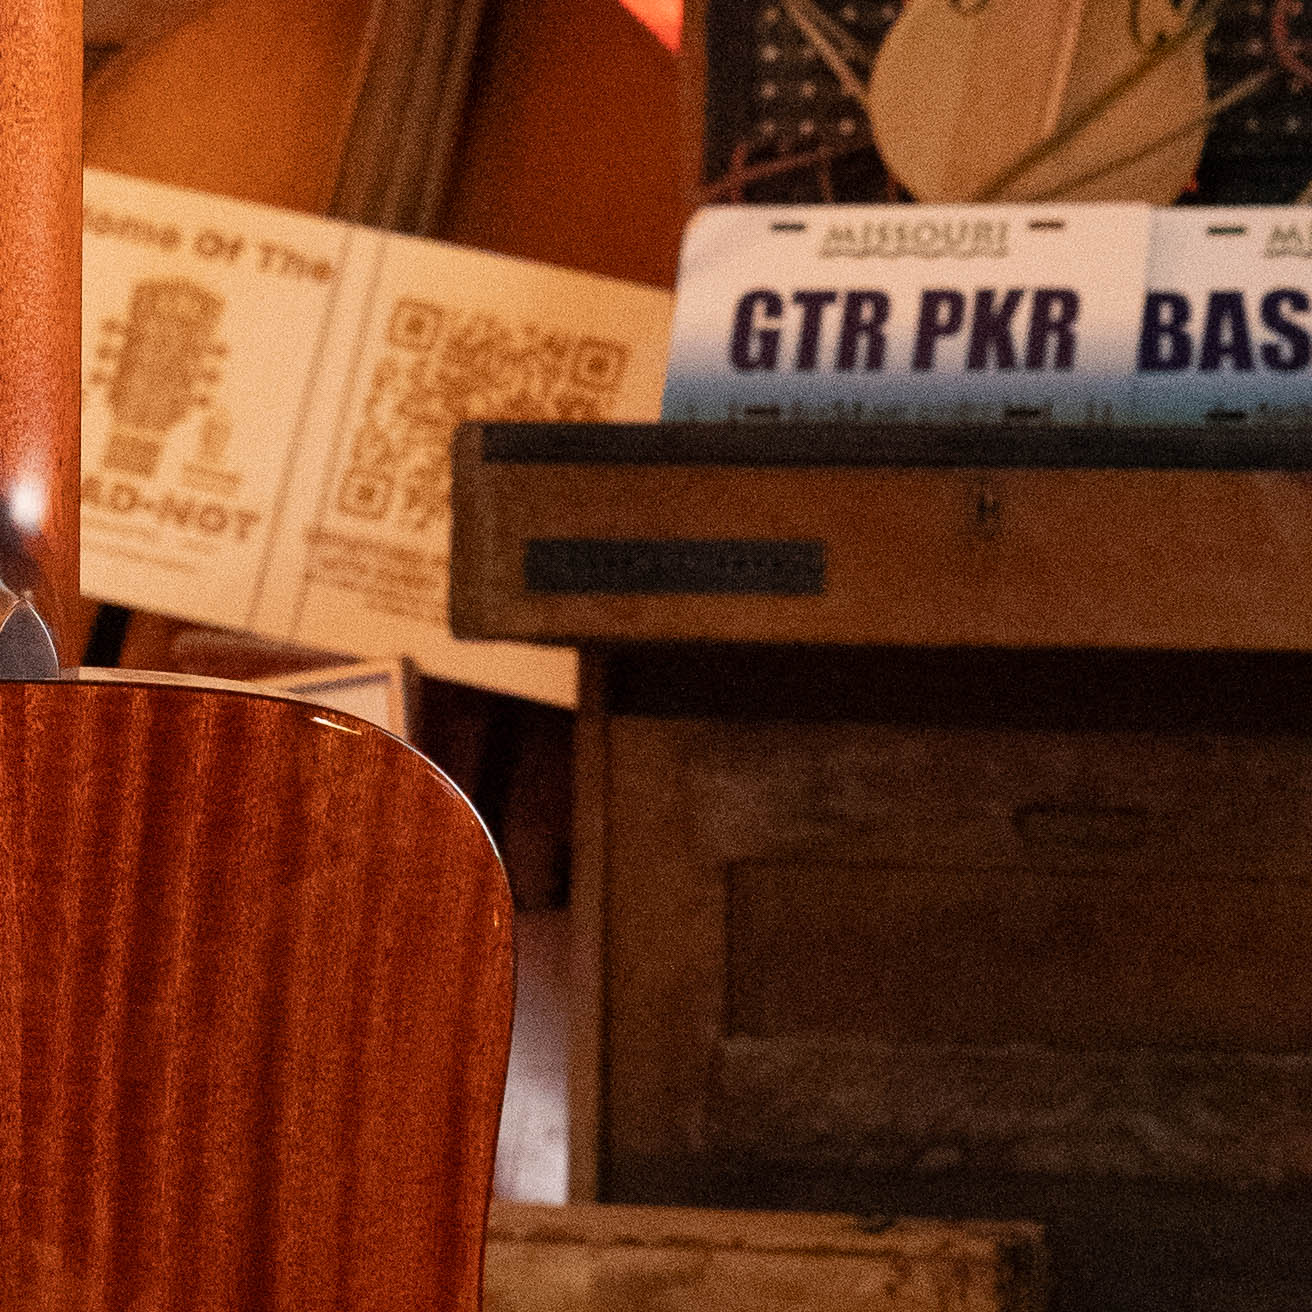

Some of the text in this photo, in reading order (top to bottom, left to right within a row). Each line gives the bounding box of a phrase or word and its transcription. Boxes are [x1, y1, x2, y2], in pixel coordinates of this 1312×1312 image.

[818, 218, 1010, 258] MISSOURI
[728, 286, 1082, 374] GTR PKR
